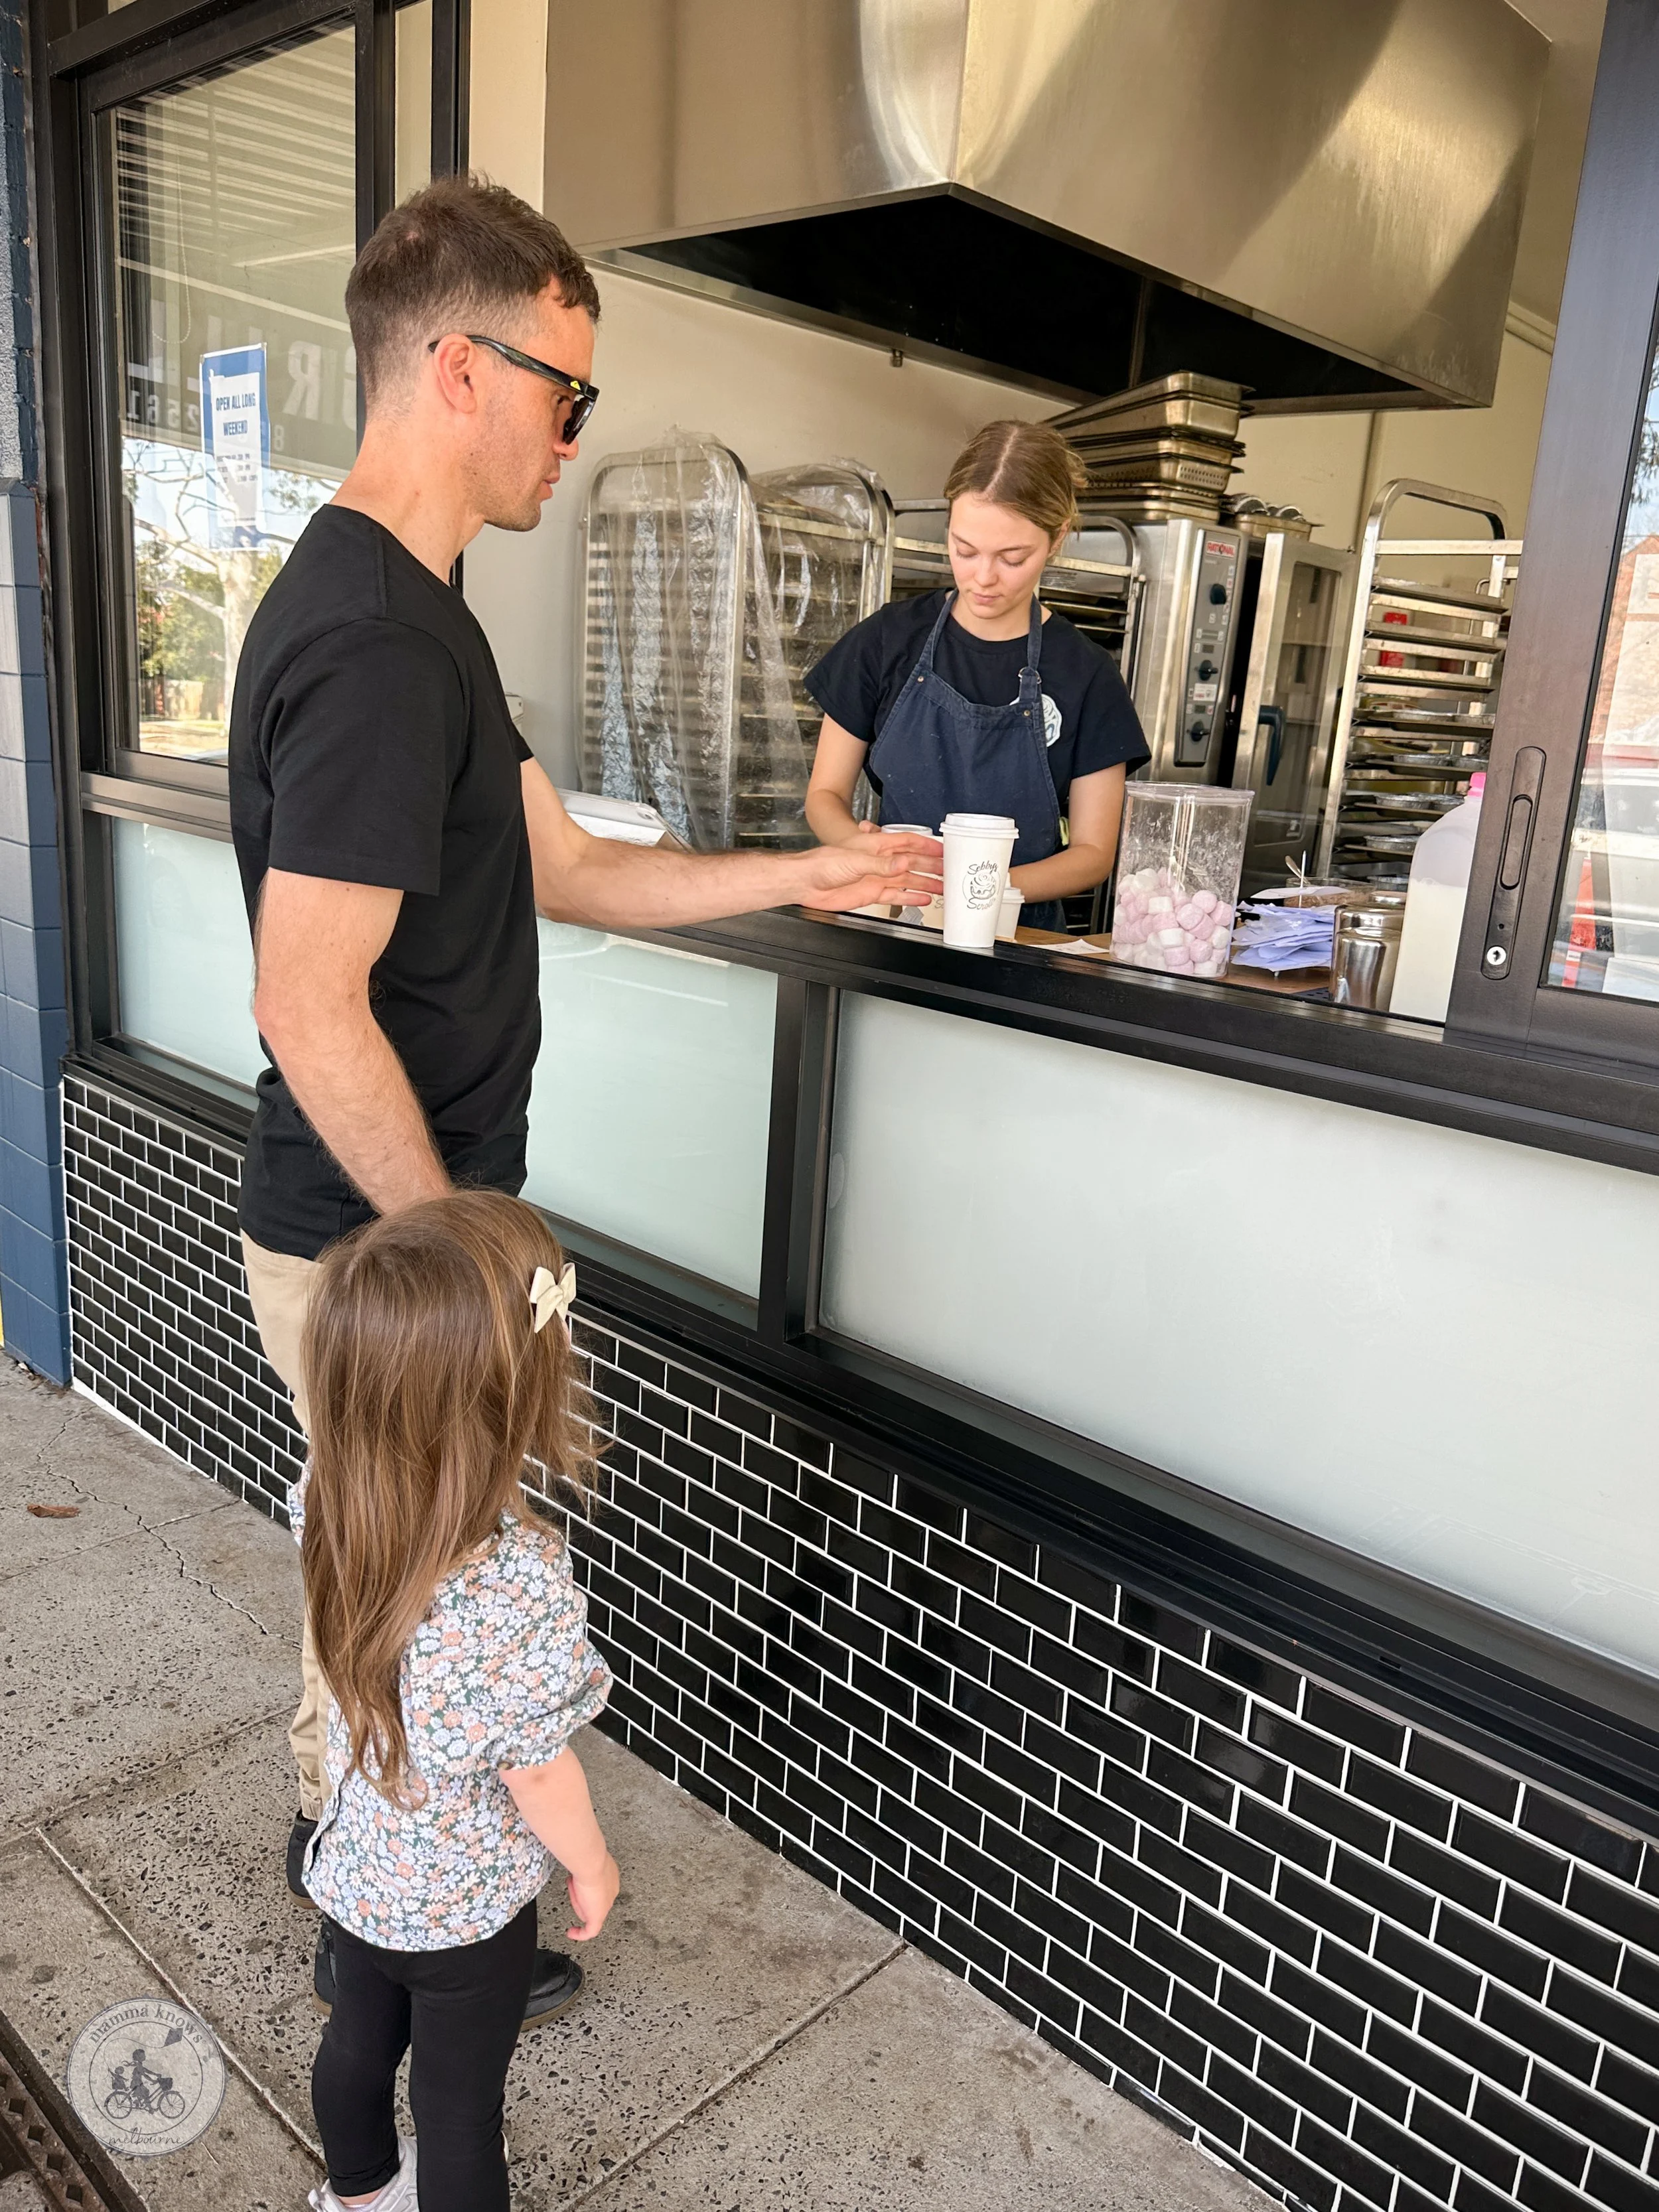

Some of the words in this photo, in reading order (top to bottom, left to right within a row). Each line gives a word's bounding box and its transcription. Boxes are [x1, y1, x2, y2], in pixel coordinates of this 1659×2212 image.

[216, 396, 230, 411] OPEN
[232, 395, 242, 409] ALL
[242, 392, 256, 407] LONG
[223, 419, 248, 436] WEEKEND
